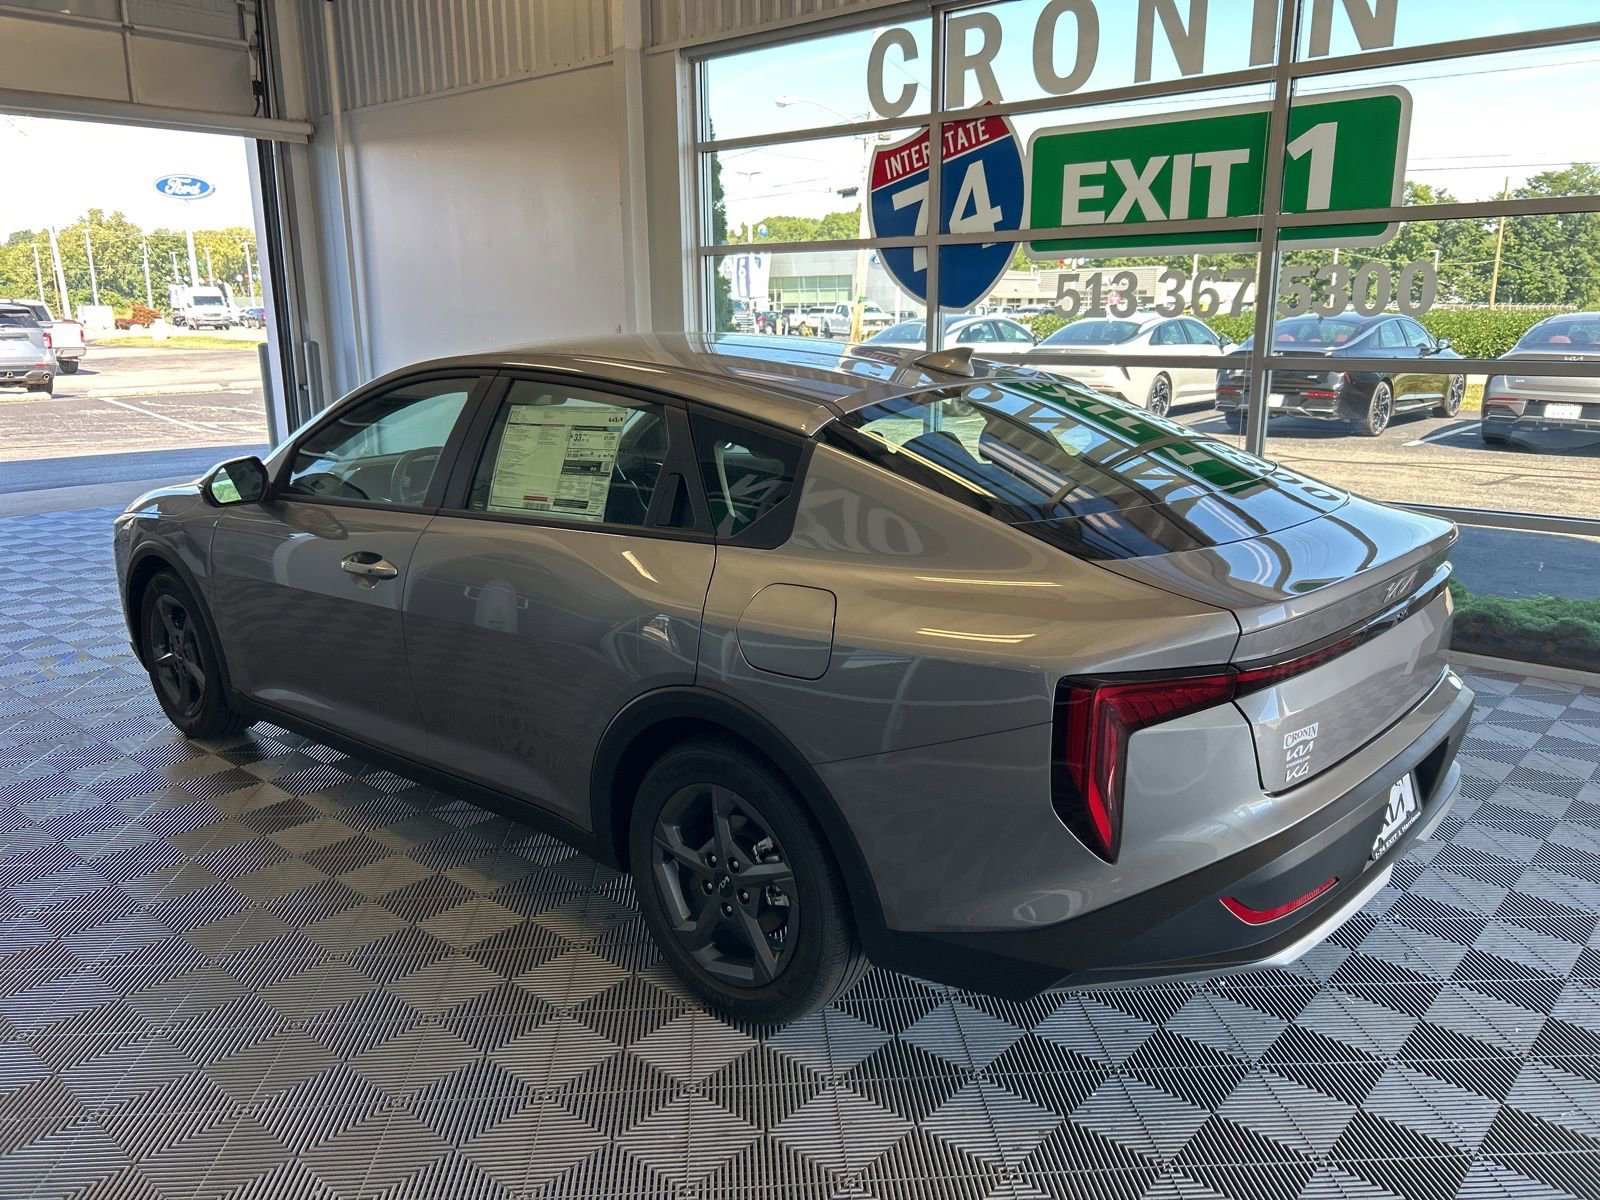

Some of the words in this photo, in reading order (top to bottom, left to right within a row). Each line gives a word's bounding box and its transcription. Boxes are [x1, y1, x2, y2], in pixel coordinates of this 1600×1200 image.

[867, 0, 1398, 119] CRONIN
[884, 118, 990, 180] INTERTATE
[1061, 149, 1250, 226] EXIT
[1287, 121, 1338, 211] 1
[165, 178, 201, 195] Ford
[891, 159, 1004, 273] 74
[1275, 260, 1438, 318] 5300
[1285, 724, 1317, 747] CRONIN
[1286, 740, 1314, 762] KIA
[1285, 762, 1309, 783] K4
